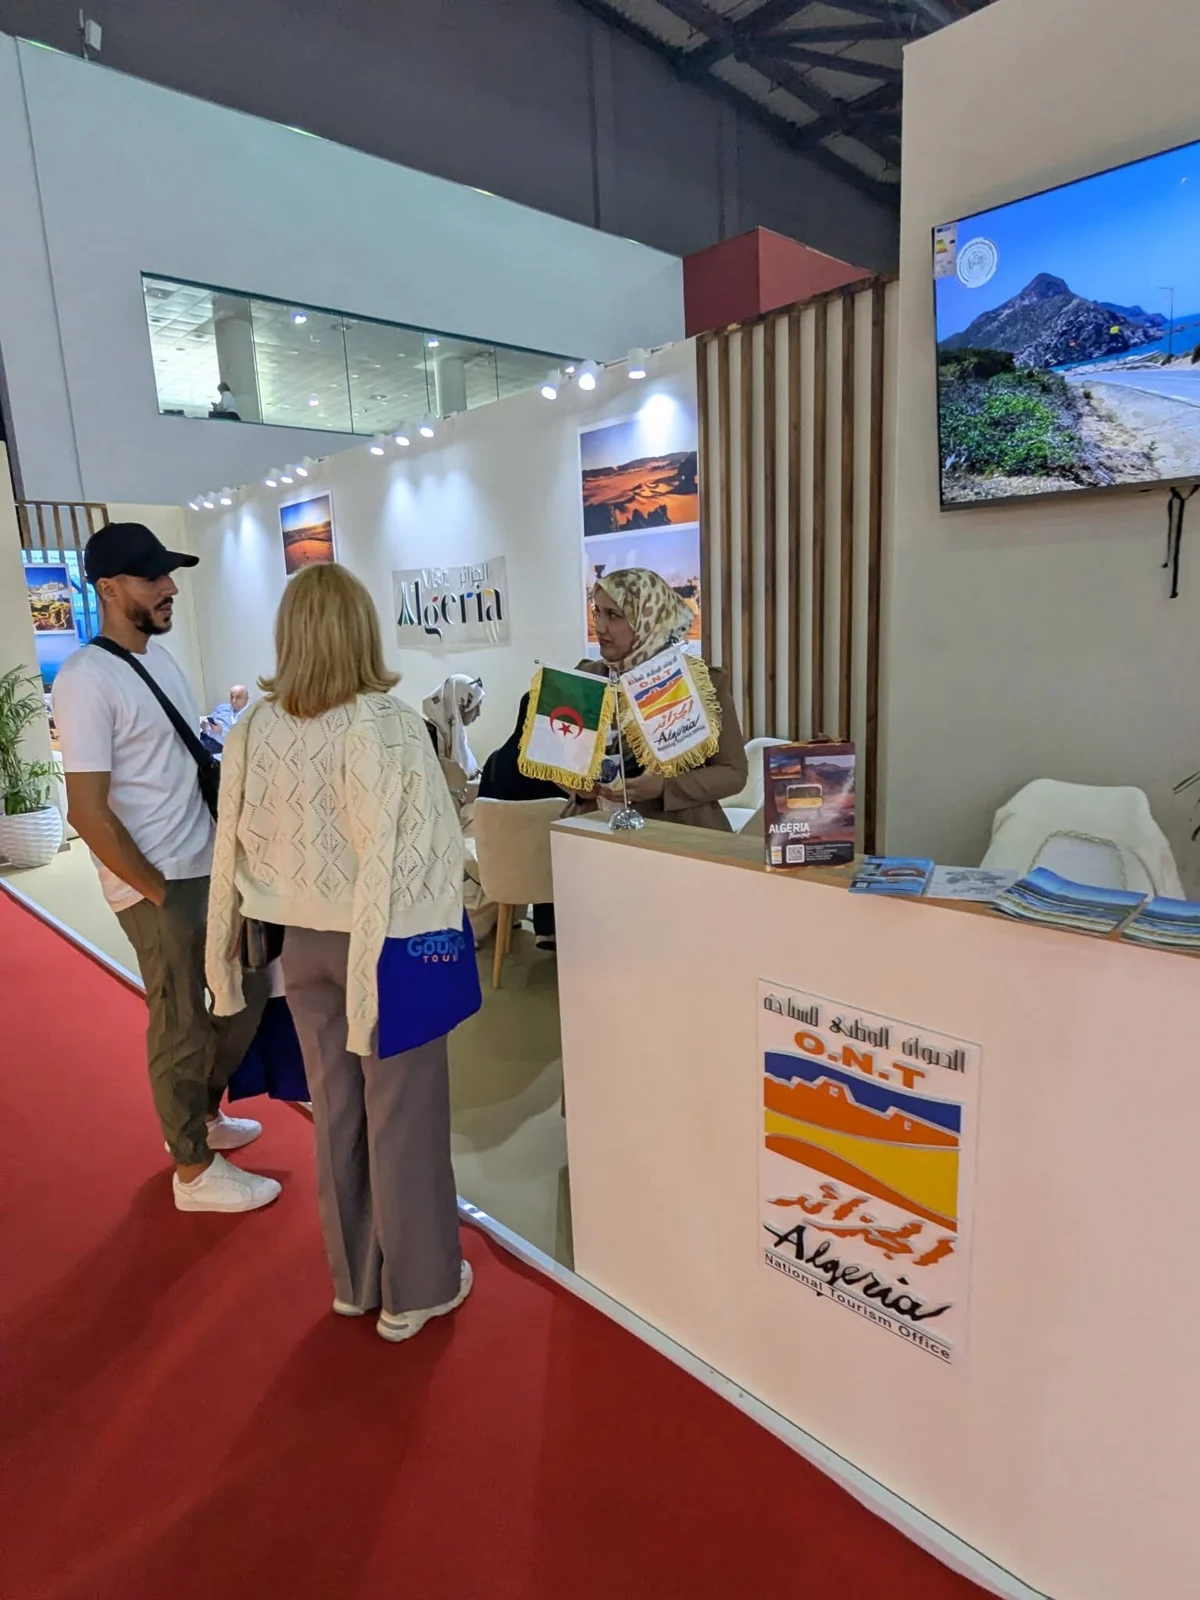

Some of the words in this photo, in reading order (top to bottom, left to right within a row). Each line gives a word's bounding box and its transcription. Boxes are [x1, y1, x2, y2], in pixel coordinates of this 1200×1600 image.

[397, 579, 503, 641] Algeria
[639, 668, 672, 688] O.N.T
[653, 713, 700, 746] Algeria
[768, 822, 811, 834] ALGERIA
[829, 1015, 890, 1050] الوطني
[902, 1037, 966, 1074] الديوان
[794, 1031, 926, 1090] O.N.T
[766, 1184, 955, 1267] الجزائر
[763, 1224, 953, 1321] Algeria
[764, 1252, 823, 1291] National
[829, 1286, 892, 1329] Tourism
[898, 1324, 951, 1360] Office
